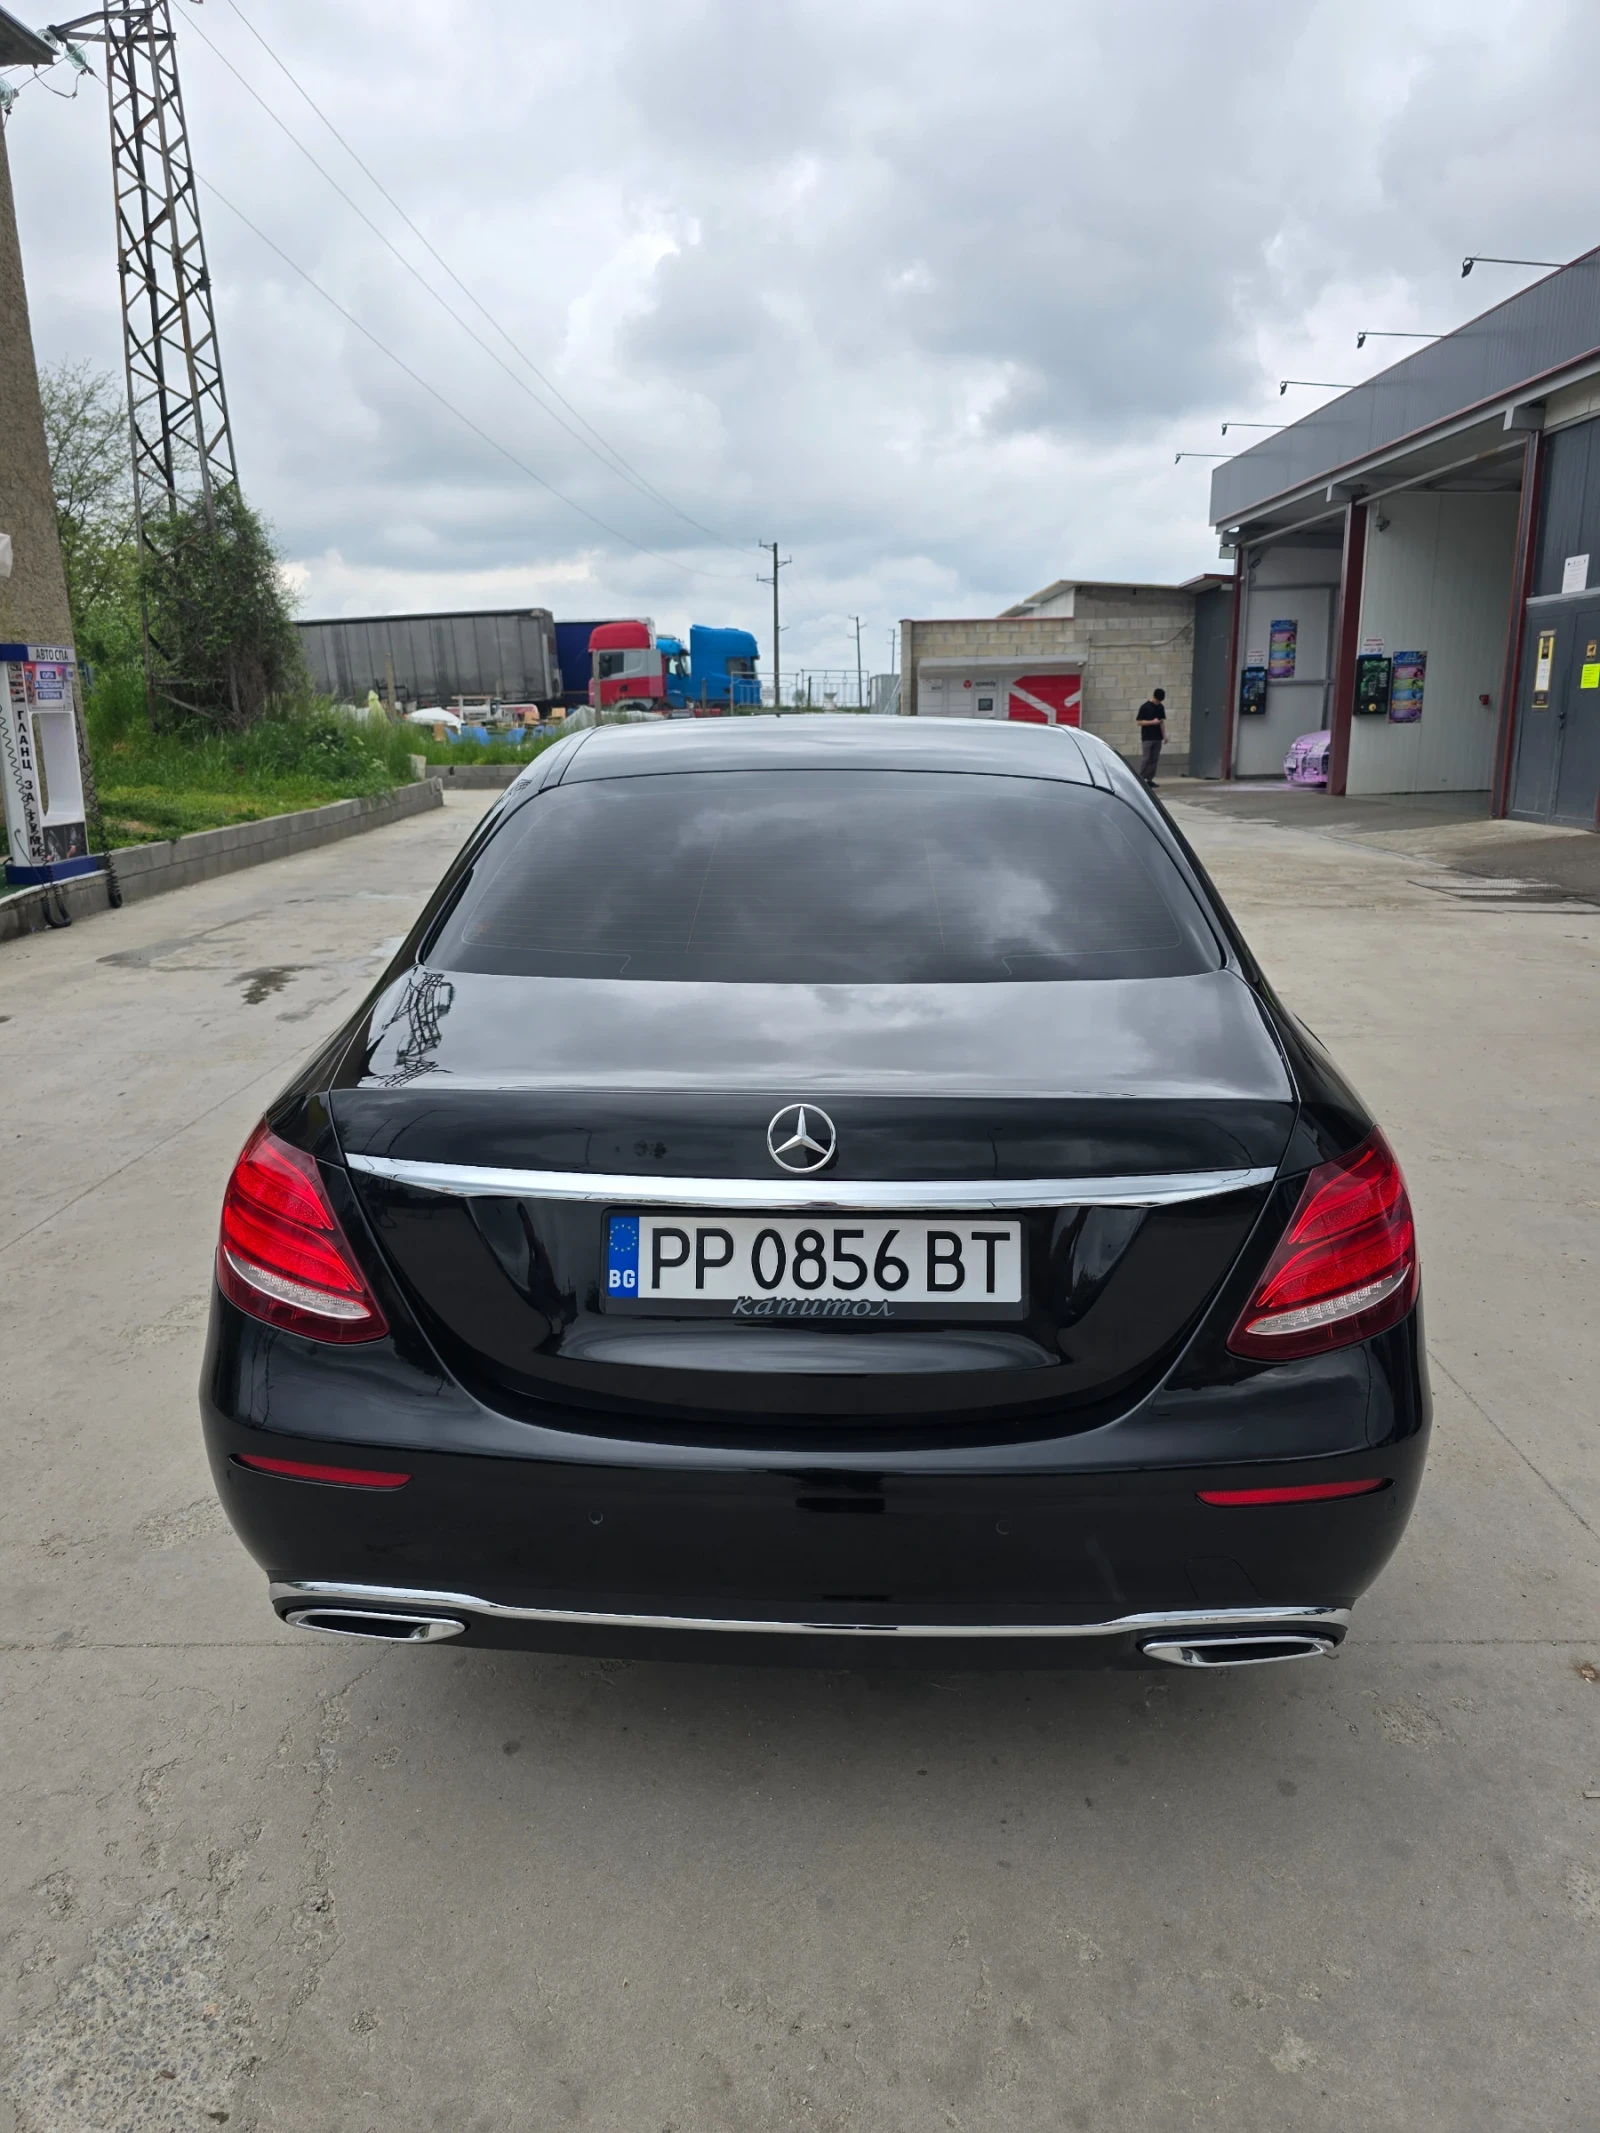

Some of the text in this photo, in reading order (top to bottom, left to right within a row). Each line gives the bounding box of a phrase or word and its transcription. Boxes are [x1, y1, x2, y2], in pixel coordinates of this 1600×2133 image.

[36, 648, 69, 661] АВТО СПА
[17, 710, 33, 771] ГЛАНЦ
[24, 780, 35, 802] ЗА
[651, 1227, 1011, 1294] PP 0856 BT
[609, 1269, 636, 1289] BG
